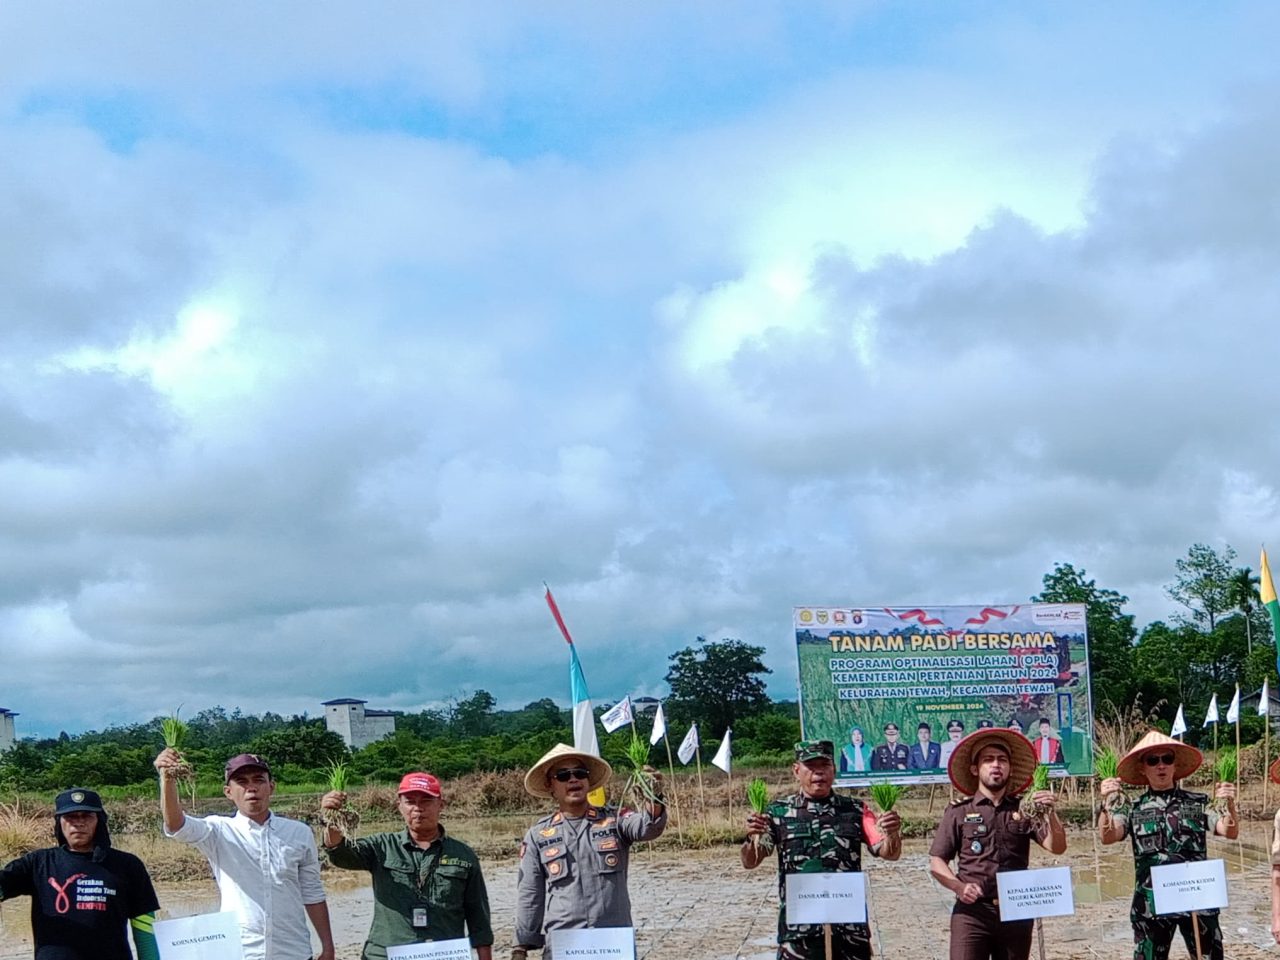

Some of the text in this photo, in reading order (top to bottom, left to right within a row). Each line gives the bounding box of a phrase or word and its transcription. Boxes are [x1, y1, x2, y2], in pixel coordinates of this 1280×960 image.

[829, 632, 1057, 652] TANAM PADI BERSAMA
[830, 655, 1058, 669] PROGRAM OPTIMALISASI LAHAN (OPLA)
[833, 668, 1057, 682] KEMENTERIAN PERTANIAN TAHUN 2024
[840, 684, 1054, 698] KELURAHAN TEWAH, KECAMATAN TEWAH
[76, 902, 106, 911] GEMPITA
[198, 934, 226, 942] GEMPITA
[435, 949, 468, 957] PENERAPAN
